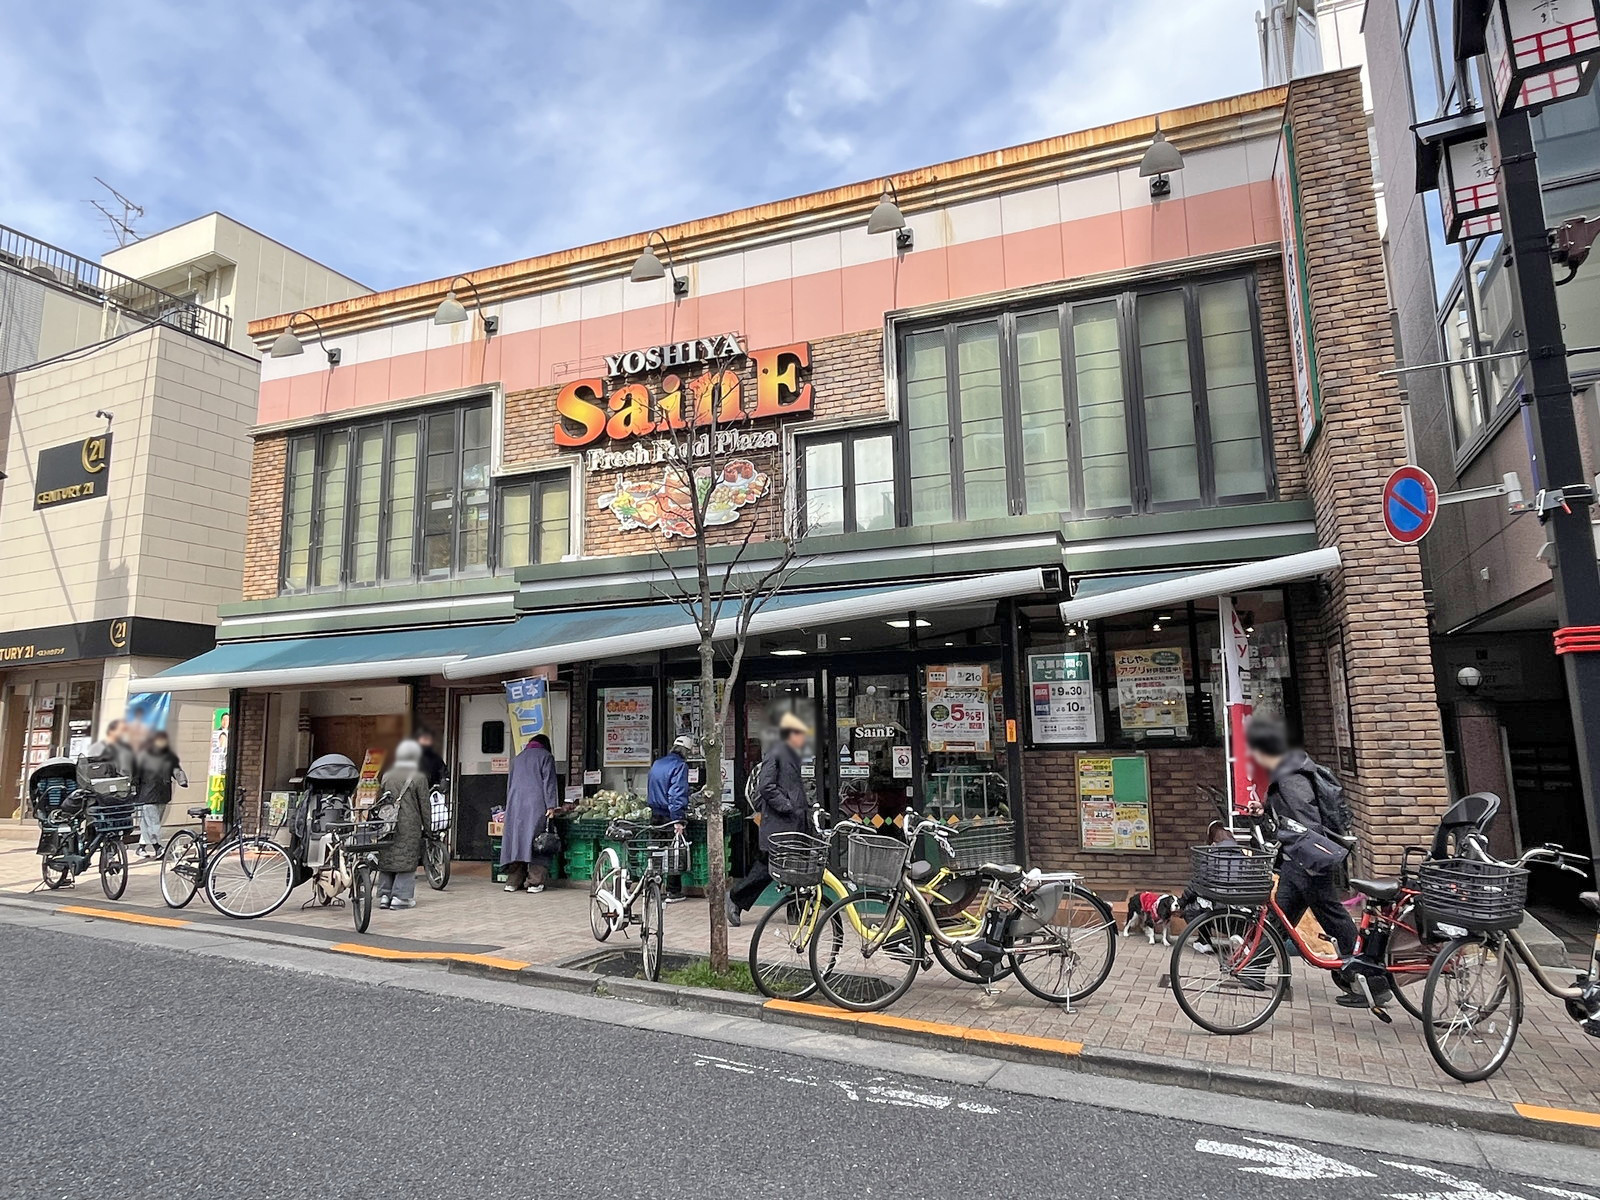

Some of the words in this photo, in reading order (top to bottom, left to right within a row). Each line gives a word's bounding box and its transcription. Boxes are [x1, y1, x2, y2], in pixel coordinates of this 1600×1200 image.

[603, 333, 744, 377] YOSHIYA
[553, 341, 814, 447] SainE
[586, 442, 651, 472] Fresh
[714, 428, 779, 455] Plaza
[37, 484, 82, 504] CENTURY
[82, 481, 95, 495] 21
[24, 644, 35, 659] 21
[855, 726, 895, 738] SainE
